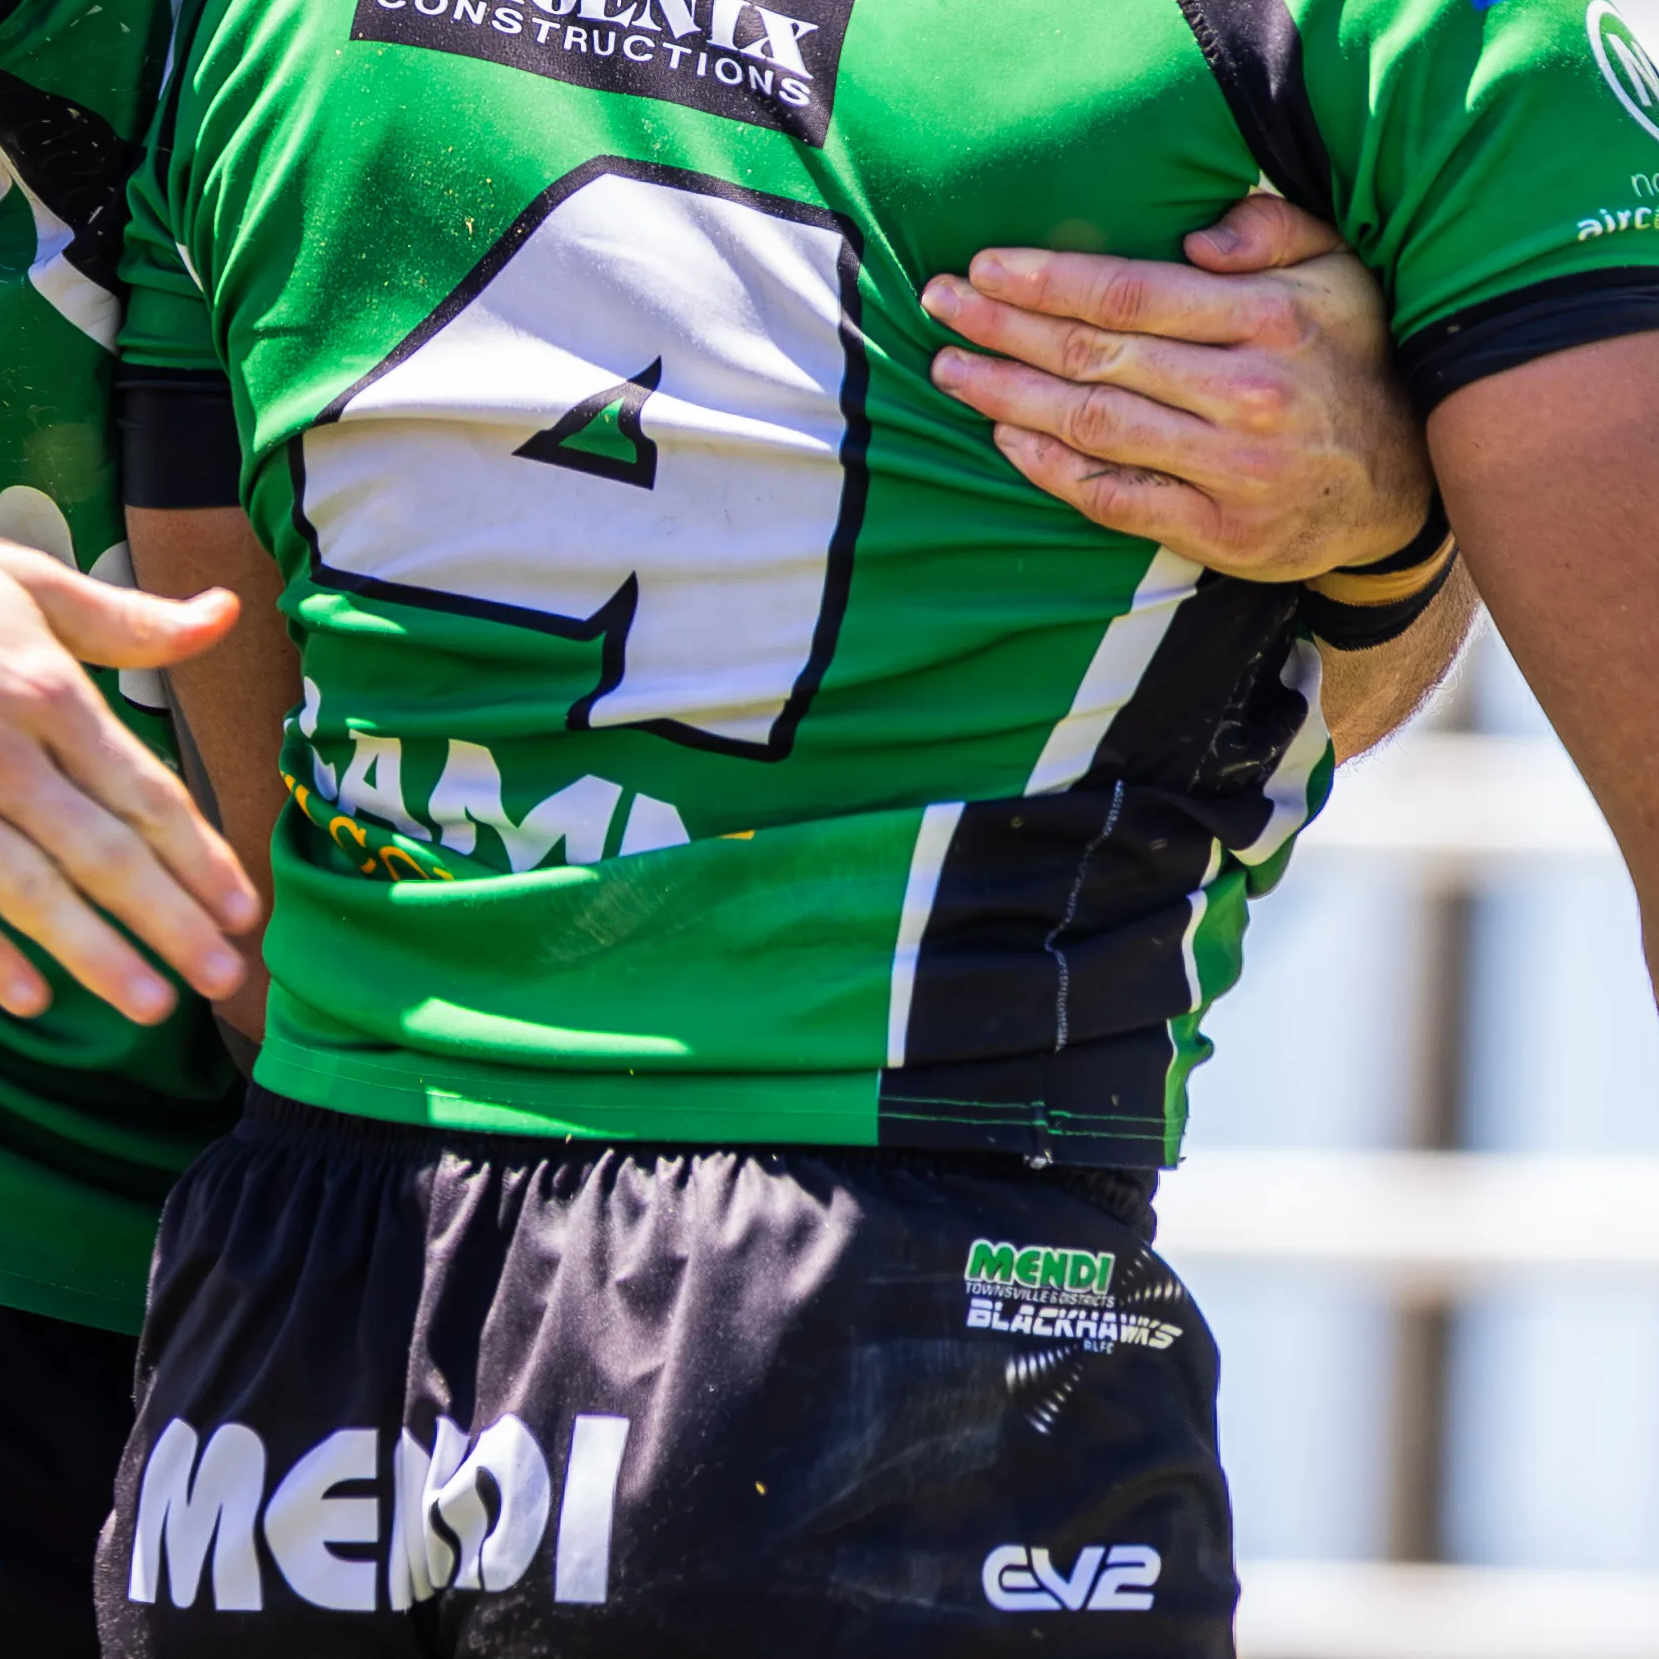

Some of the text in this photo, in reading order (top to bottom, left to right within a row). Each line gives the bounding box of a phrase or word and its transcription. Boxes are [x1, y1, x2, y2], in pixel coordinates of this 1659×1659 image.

[296, 156, 861, 761] 4
[964, 1238, 1115, 1295] MENDI
[965, 1282, 1050, 1303] TOWNSVILLE
[967, 1298, 1183, 1350] BLACKHAWKS
[128, 1413, 630, 1612] MENDI
